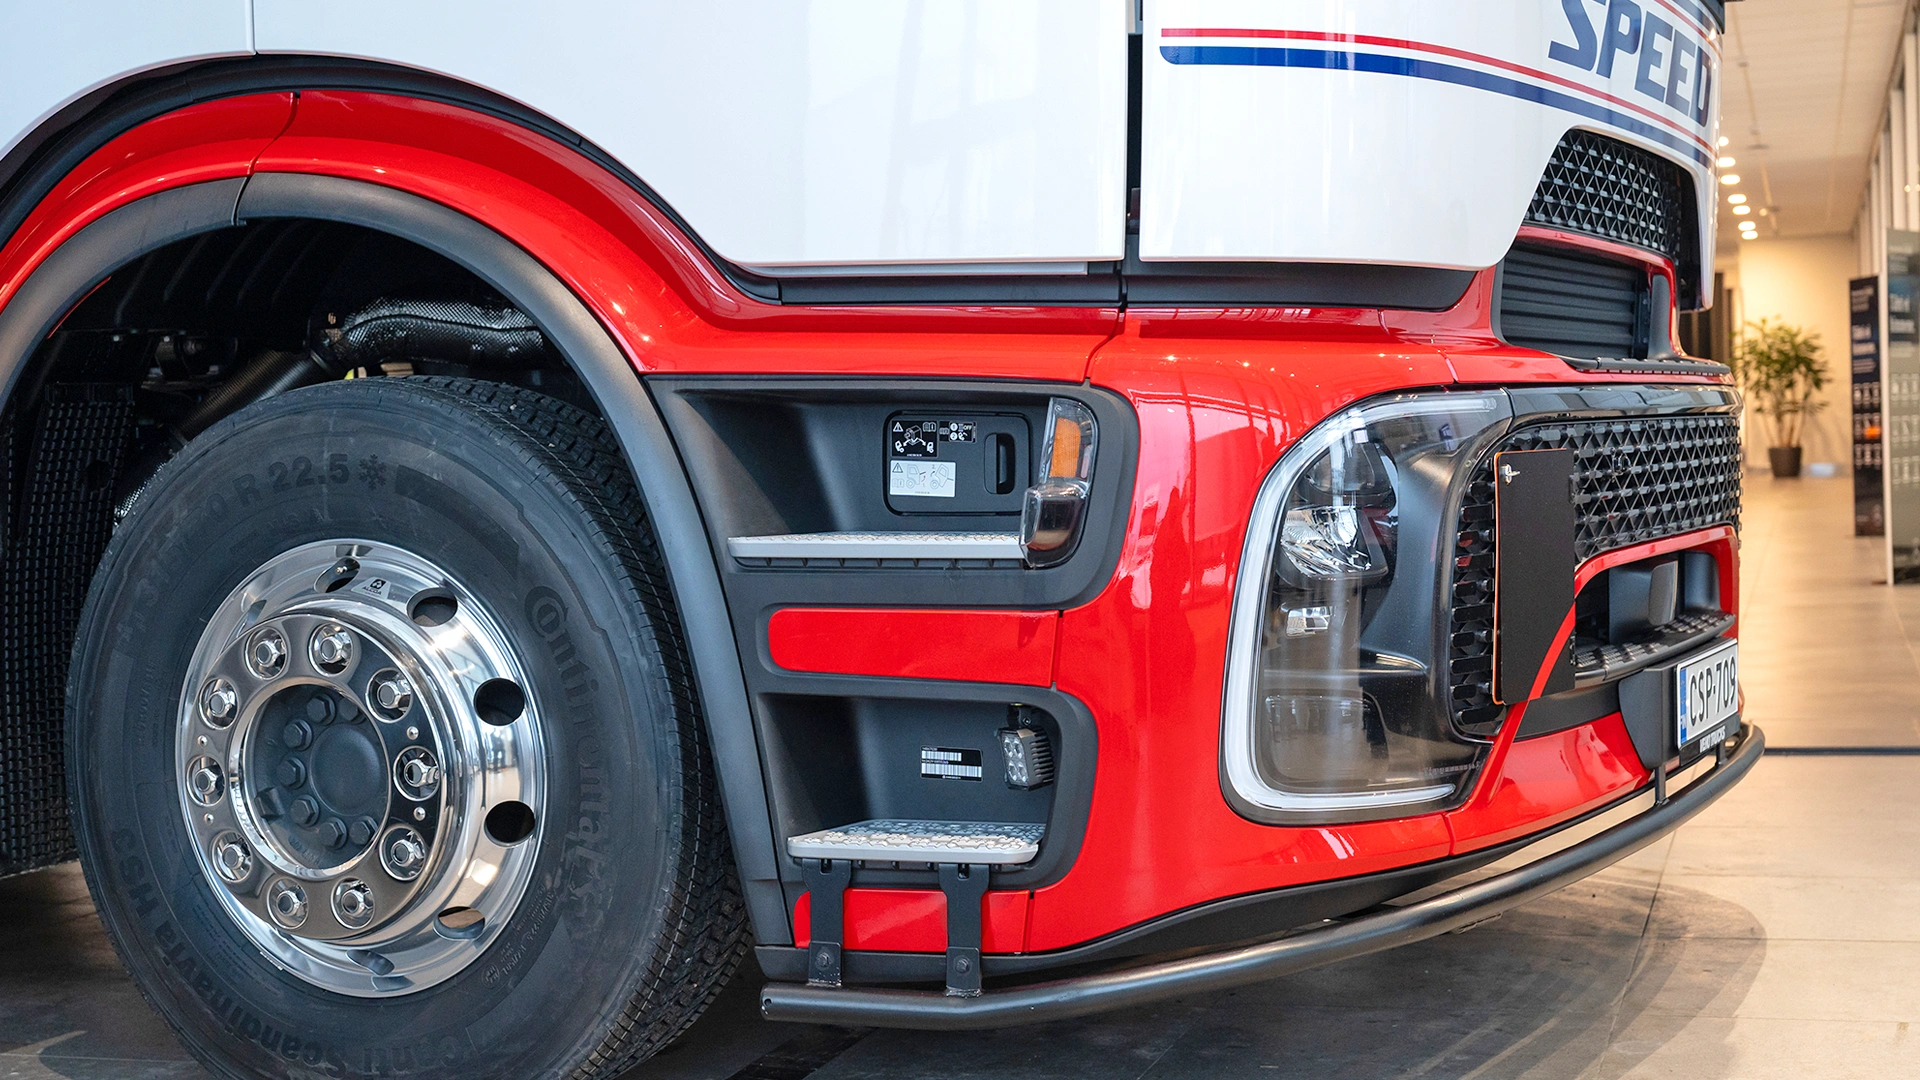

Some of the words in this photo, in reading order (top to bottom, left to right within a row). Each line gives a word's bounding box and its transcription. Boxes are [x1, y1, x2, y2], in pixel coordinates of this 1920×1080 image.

[1548, 0, 1712, 128] SPEED
[231, 473, 264, 508] R
[267, 453, 351, 494] 22.5
[362, 585, 382, 596] ALCOA
[1688, 656, 1737, 727] CSP-709
[154, 921, 347, 1079] Scandinavia
